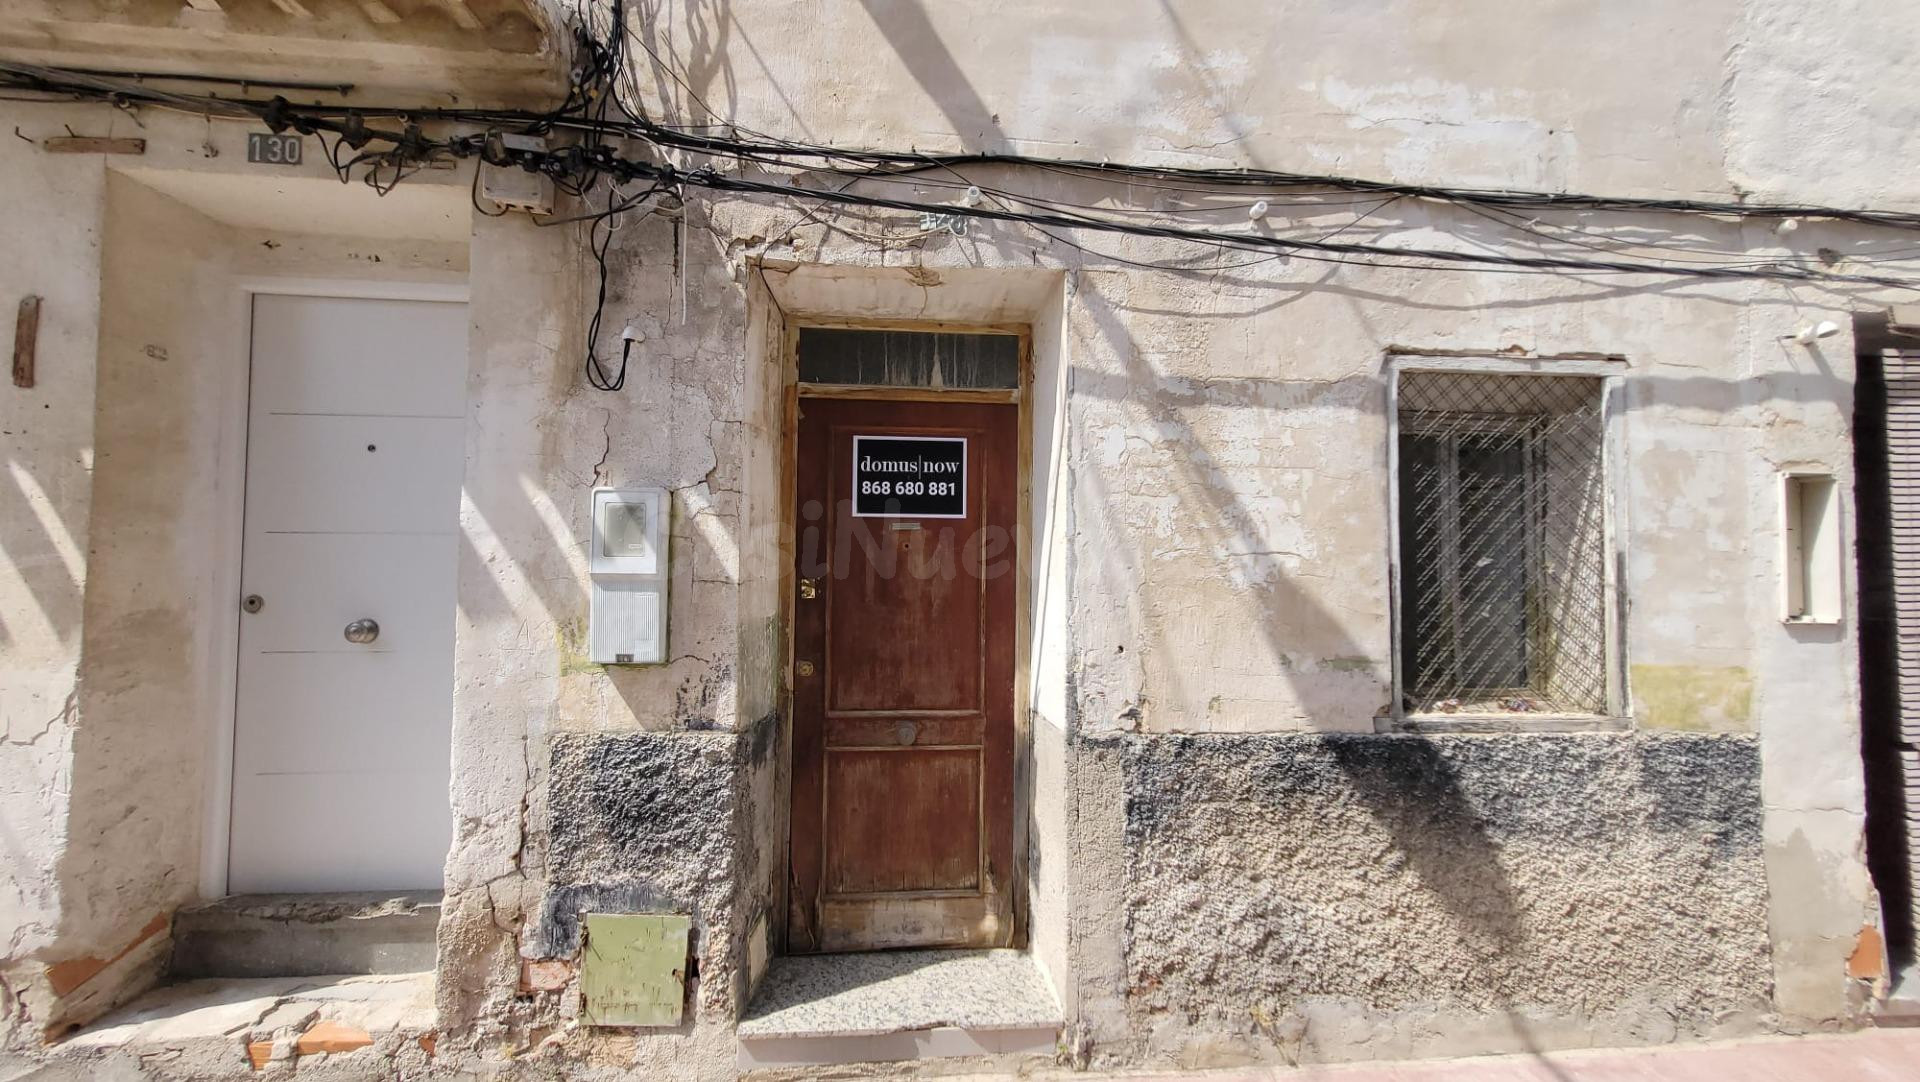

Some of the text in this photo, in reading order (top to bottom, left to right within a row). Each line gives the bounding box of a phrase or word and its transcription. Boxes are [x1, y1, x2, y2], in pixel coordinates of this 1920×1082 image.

[251, 136, 300, 163] 130
[860, 455, 918, 472] domus
[861, 480, 955, 496] 868 680 881
